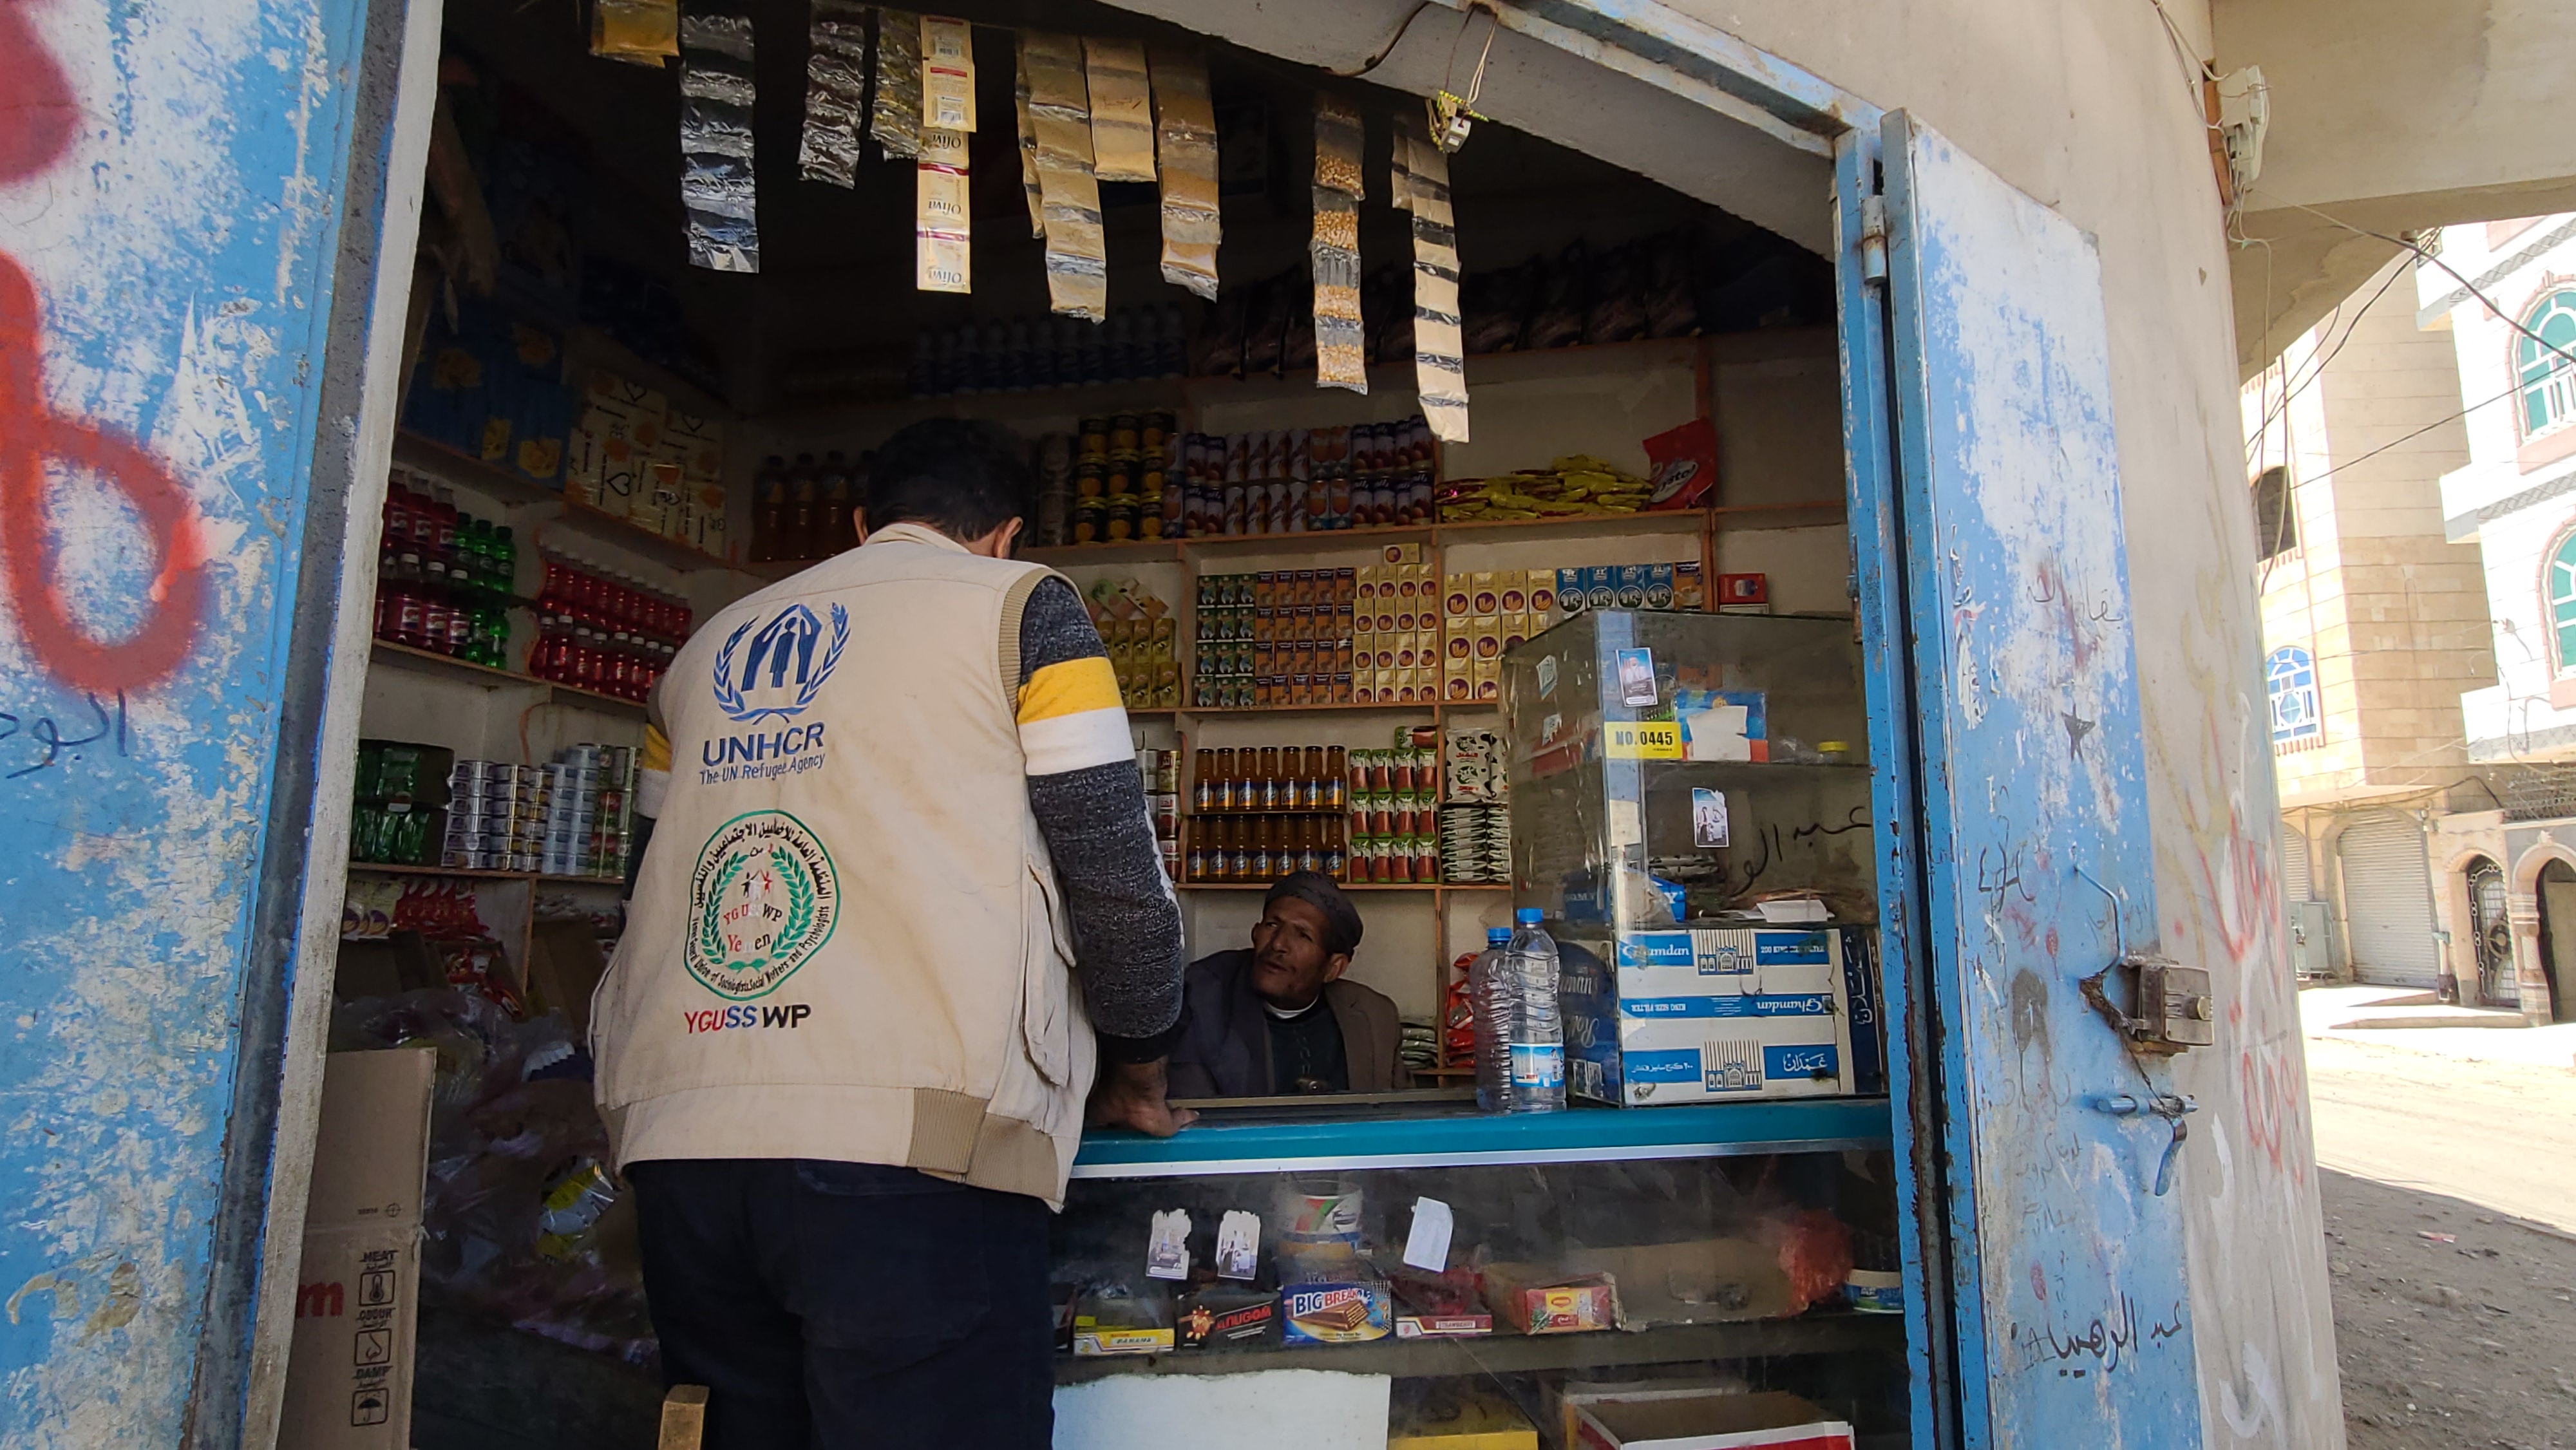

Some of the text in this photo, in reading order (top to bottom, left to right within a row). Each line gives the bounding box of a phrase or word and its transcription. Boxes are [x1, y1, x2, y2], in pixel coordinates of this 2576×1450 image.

[929, 200, 961, 216] Oliva
[703, 721, 825, 767] UNHCR
[699, 753, 826, 785] The UN Refugee Agency
[1622, 944, 1690, 959] Gamdan
[1756, 998, 1823, 1013] Ghamdan
[1294, 1292, 1323, 1315] BIG
